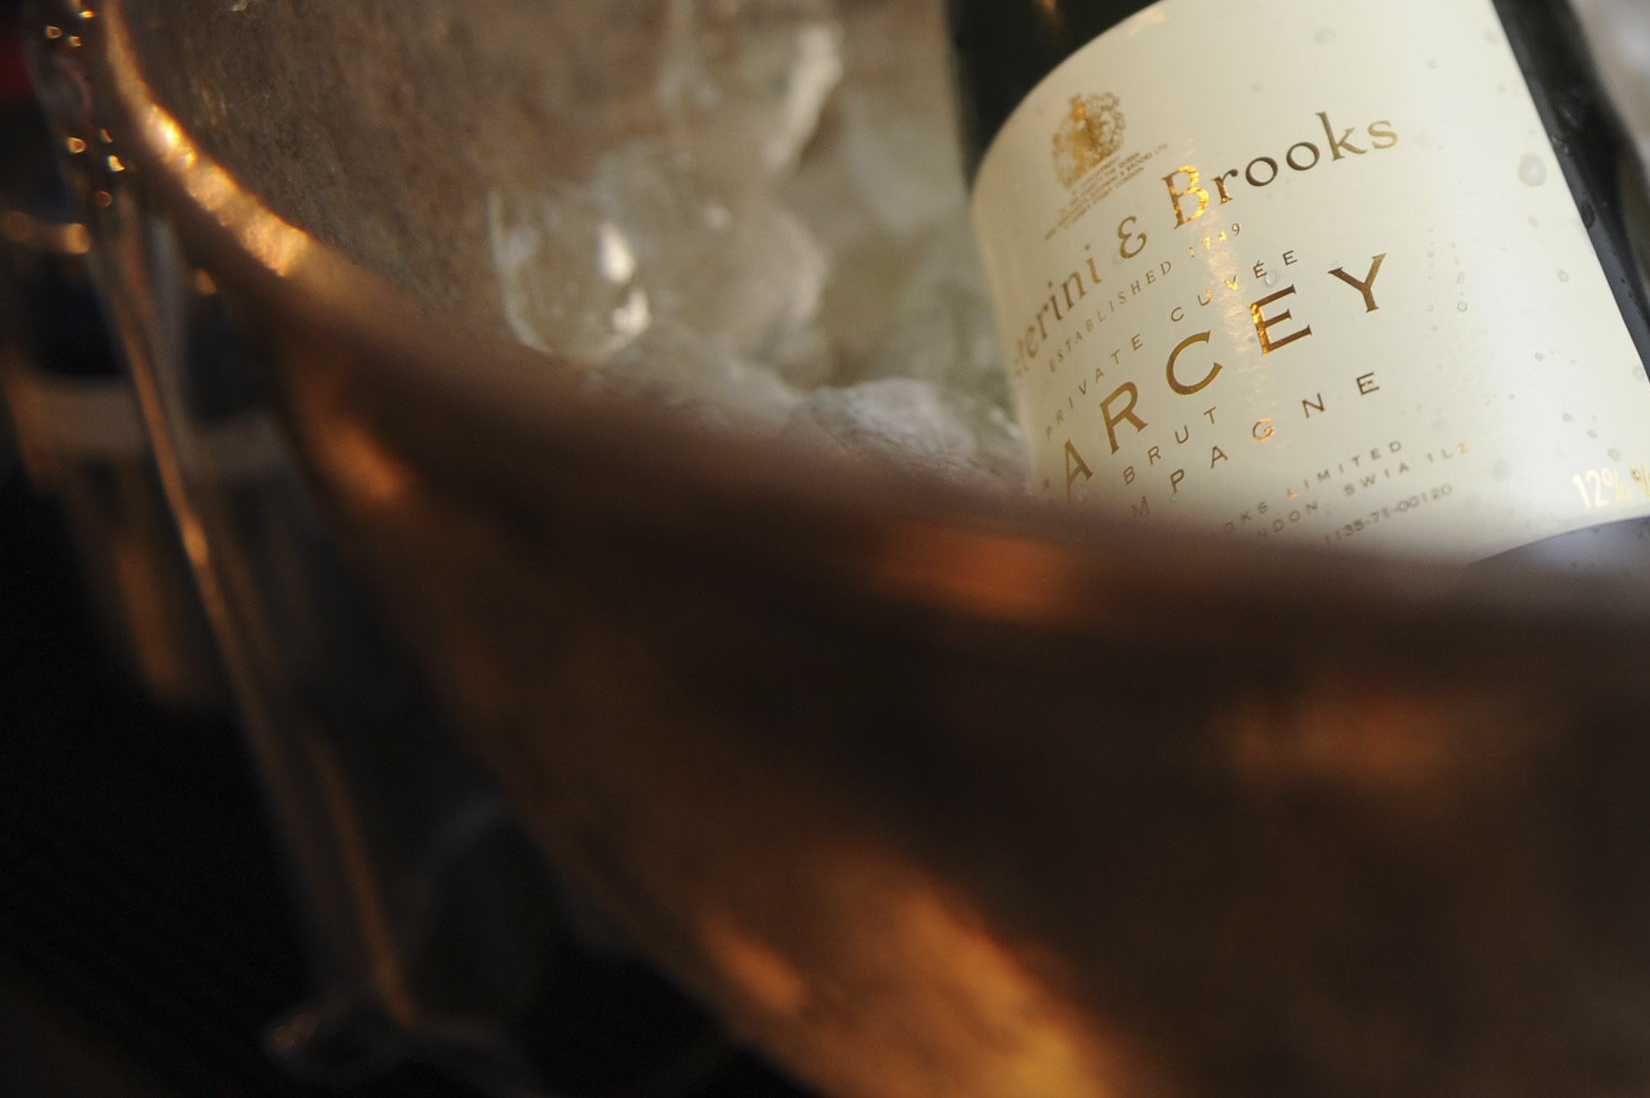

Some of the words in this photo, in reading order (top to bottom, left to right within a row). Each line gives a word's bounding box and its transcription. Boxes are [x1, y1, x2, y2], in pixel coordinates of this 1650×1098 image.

[1117, 215, 1148, 260] &
[1160, 110, 1399, 230] Brooks
[1045, 333, 1144, 442] PRIVATE
[1169, 249, 1299, 323] CUVÉE
[1049, 260, 1173, 375] ESTABLISHED
[1188, 222, 1241, 259] 1749
[1060, 252, 1388, 504] ARCEY
[1122, 406, 1218, 486] BRUT
[1130, 370, 1381, 518] MPAGNE
[1287, 439, 1403, 500] LIMITED
[1572, 466, 1634, 510] 12%
